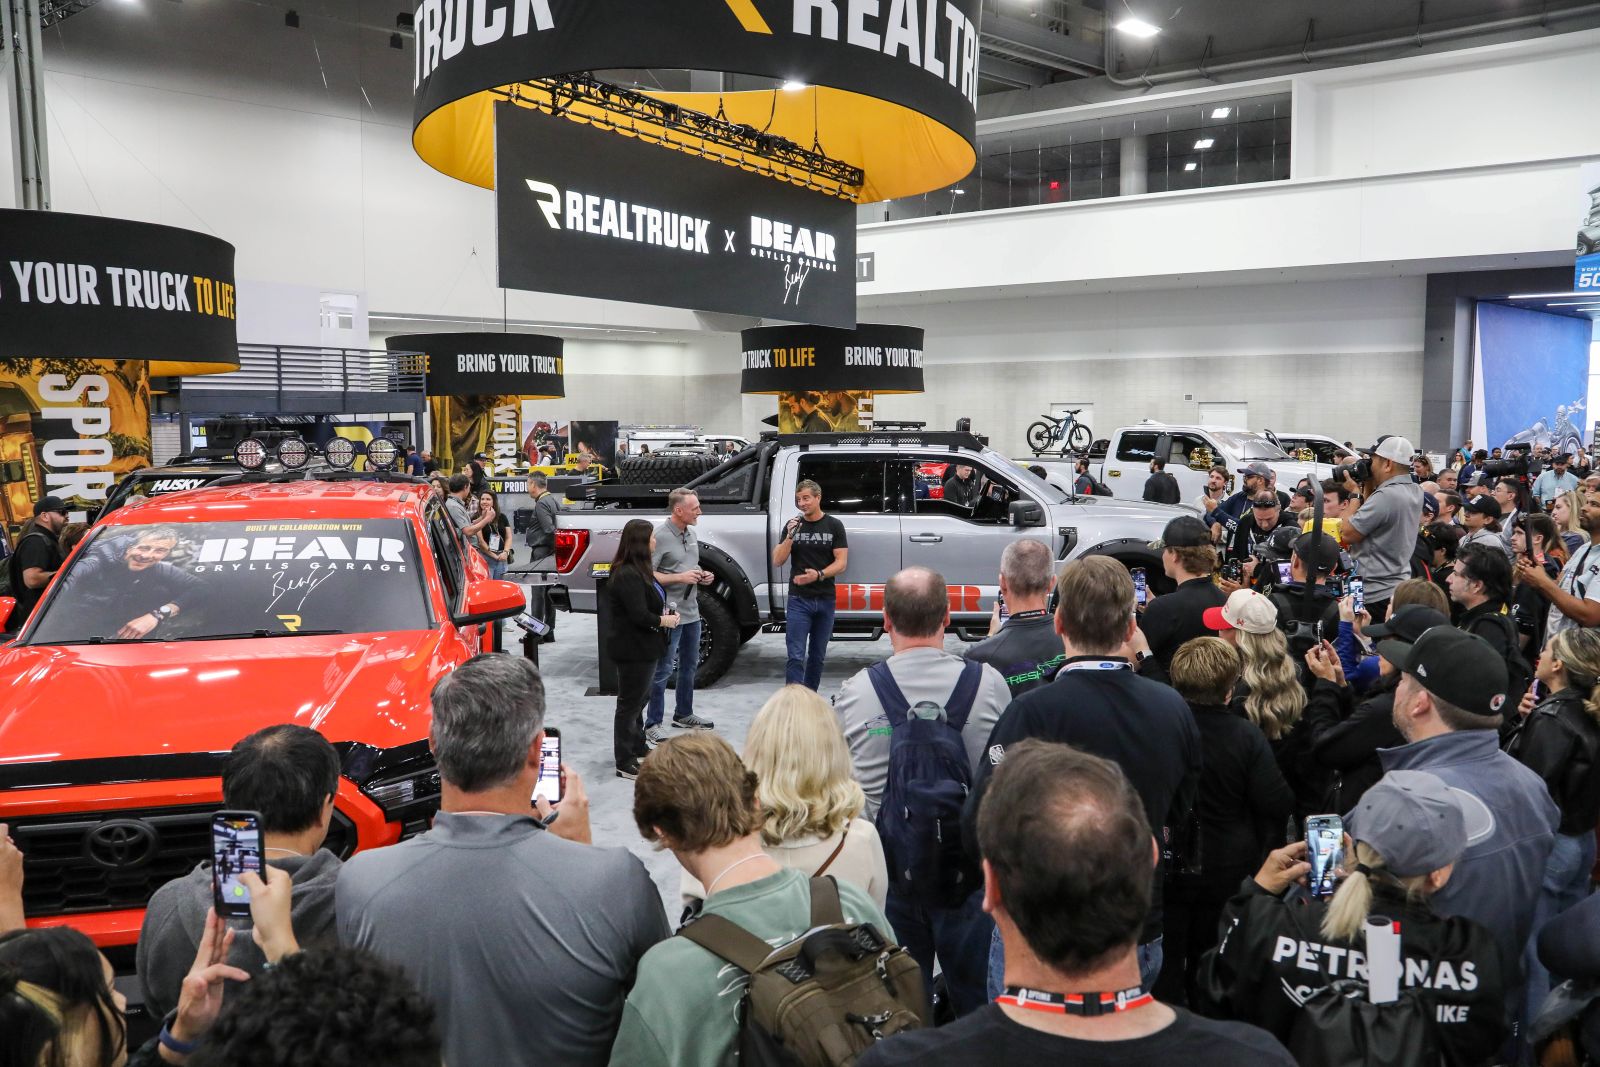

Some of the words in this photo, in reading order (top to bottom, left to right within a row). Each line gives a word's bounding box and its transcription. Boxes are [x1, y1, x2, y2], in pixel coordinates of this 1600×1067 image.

[566, 190, 710, 254] REALTRUCK
[751, 215, 836, 262] BEAR
[10, 260, 101, 306] YOUR
[106, 266, 191, 312] TRUCK
[193, 276, 213, 316] TO
[216, 280, 235, 320] LIFE
[457, 354, 496, 373] BRING
[499, 354, 529, 373] YOUR
[532, 355, 556, 375] TRUCK
[748, 350, 771, 369] TRUCK
[773, 348, 787, 368] TO
[790, 347, 815, 367] LIFE
[845, 346, 882, 367] BRING
[885, 347, 909, 367] YOUR
[38, 374, 115, 524] SPOR
[493, 403, 517, 473] WORK
[150, 479, 206, 492] HUSKY
[245, 524, 267, 532] BUILT
[279, 524, 341, 532] COLLABORATION
[342, 523, 363, 531] WITH
[198, 536, 405, 563] BEAR
[195, 562, 289, 573] GRYLLS
[309, 562, 406, 573] GARAGE
[1272, 935, 1479, 992] PETRNAS
